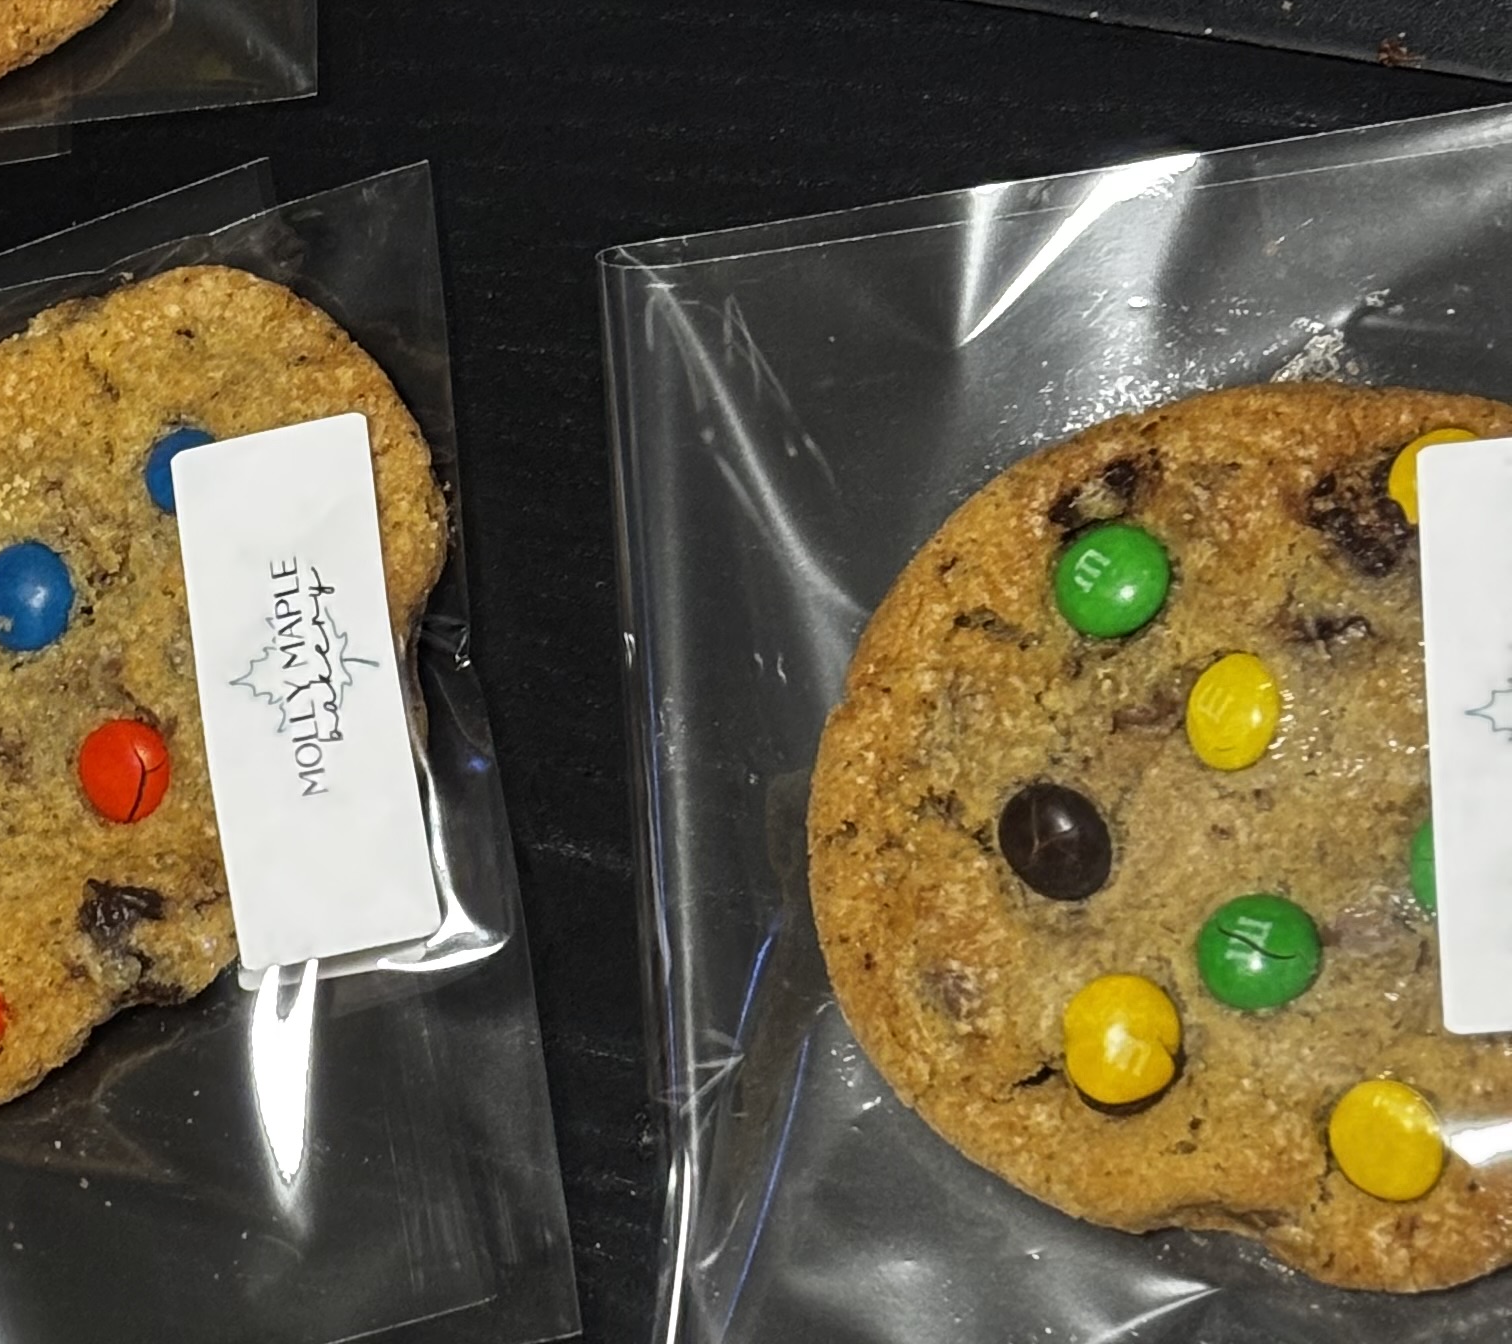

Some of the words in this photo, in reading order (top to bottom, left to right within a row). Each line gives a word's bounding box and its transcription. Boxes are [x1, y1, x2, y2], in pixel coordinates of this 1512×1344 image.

[270, 556, 307, 668] MAPLE
[1074, 549, 1111, 592] m
[306, 566, 344, 742] bakery
[284, 679, 328, 797] MOLLY
